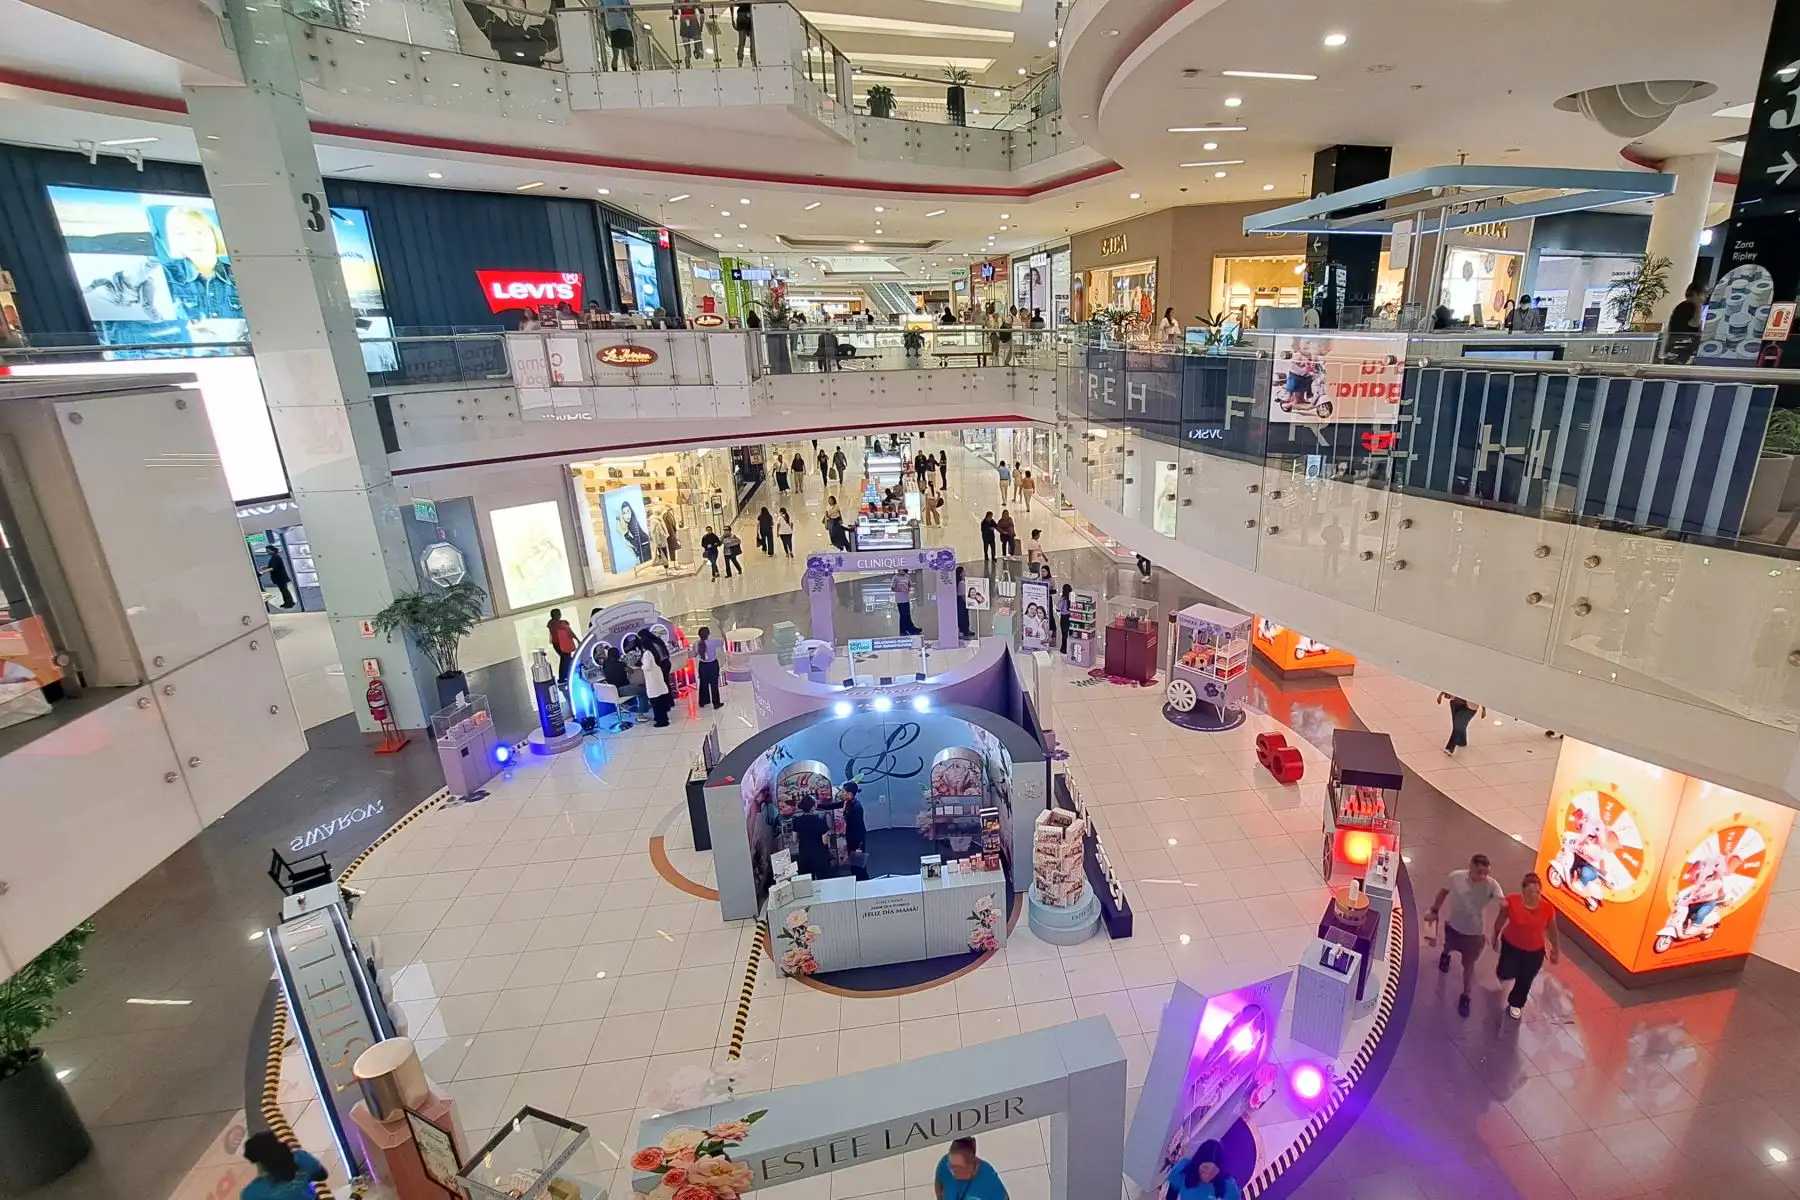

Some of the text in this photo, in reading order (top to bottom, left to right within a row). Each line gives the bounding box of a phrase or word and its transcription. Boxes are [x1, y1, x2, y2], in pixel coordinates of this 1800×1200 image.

[302, 192, 325, 232] 3
[1735, 240, 1754, 249] Zara
[1732, 251, 1757, 261] Ripley
[492, 281, 574, 300] Levi's
[857, 556, 908, 569] CLINIQUE
[862, 911, 881, 919] ¡FELIZ
[896, 905, 919, 913] MAMÁ!
[885, 1095, 1025, 1150] LAUDER
